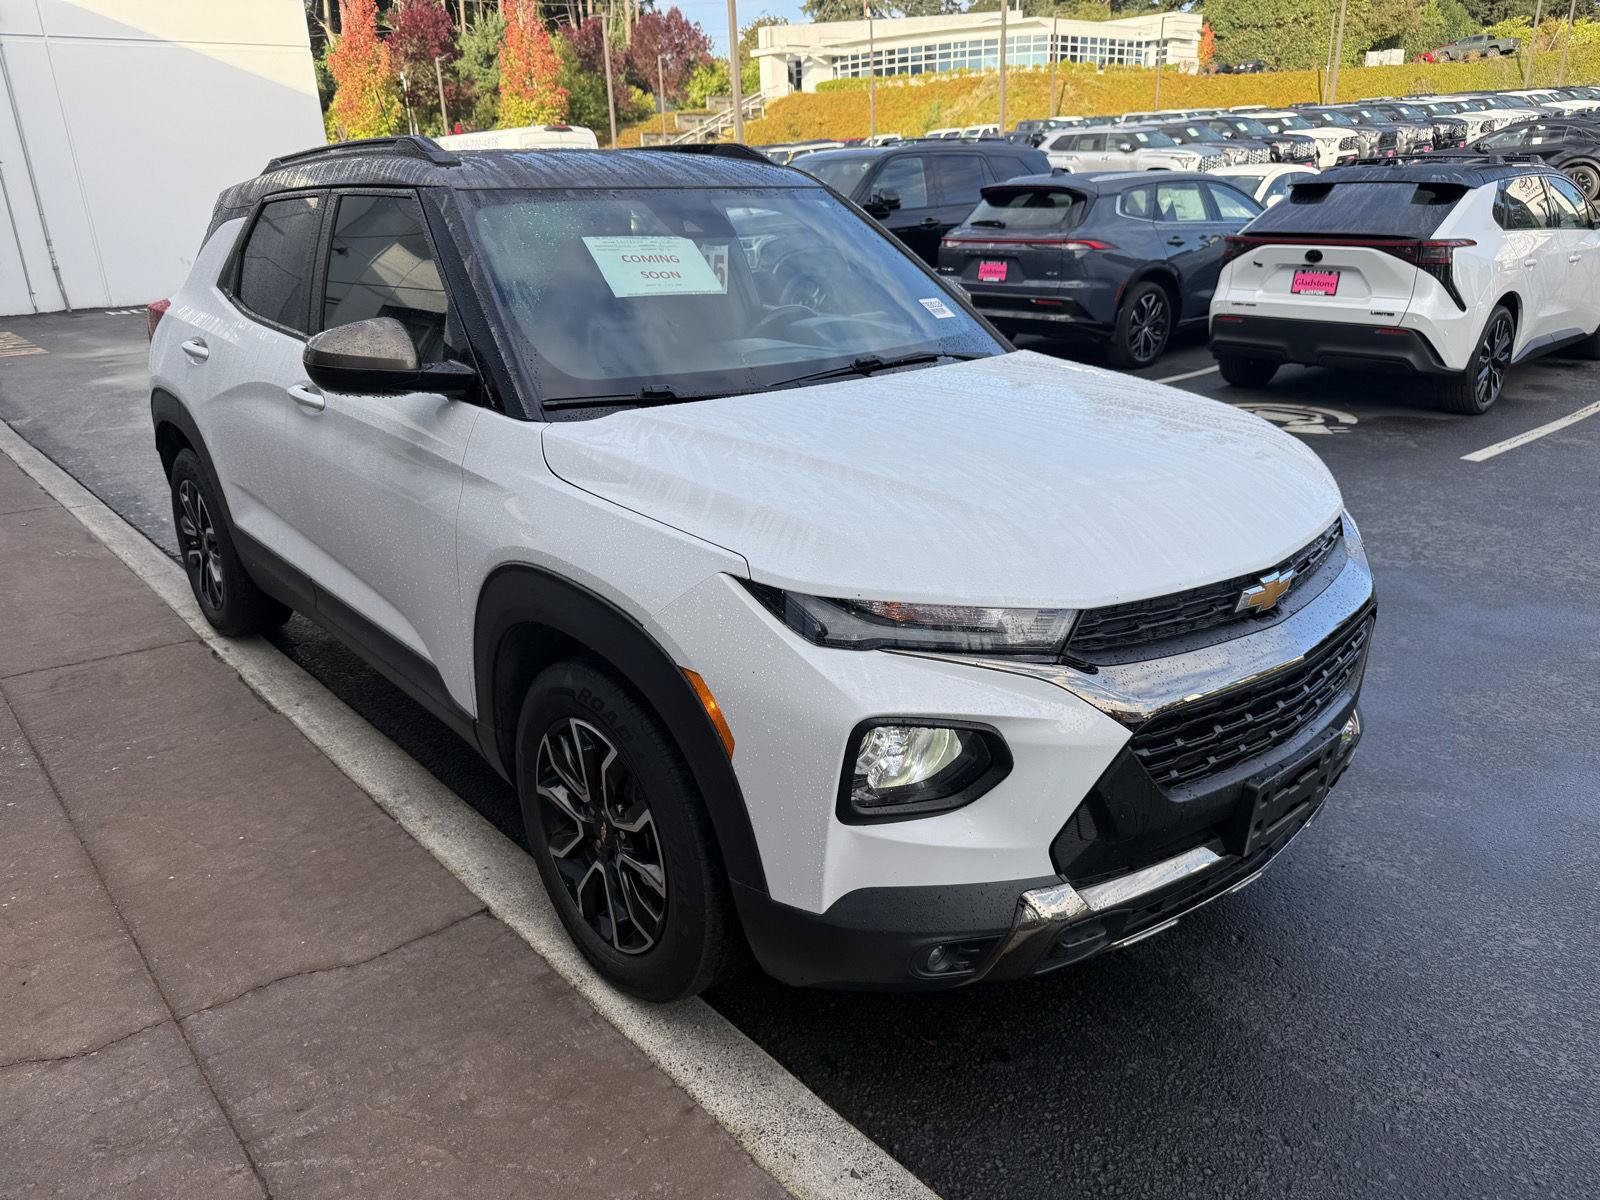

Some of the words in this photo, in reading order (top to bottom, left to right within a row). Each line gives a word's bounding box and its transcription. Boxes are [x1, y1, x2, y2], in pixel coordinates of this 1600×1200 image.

[621, 254, 681, 264] COMING
[640, 270, 682, 279] SOON
[1294, 278, 1335, 288] Gladstone
